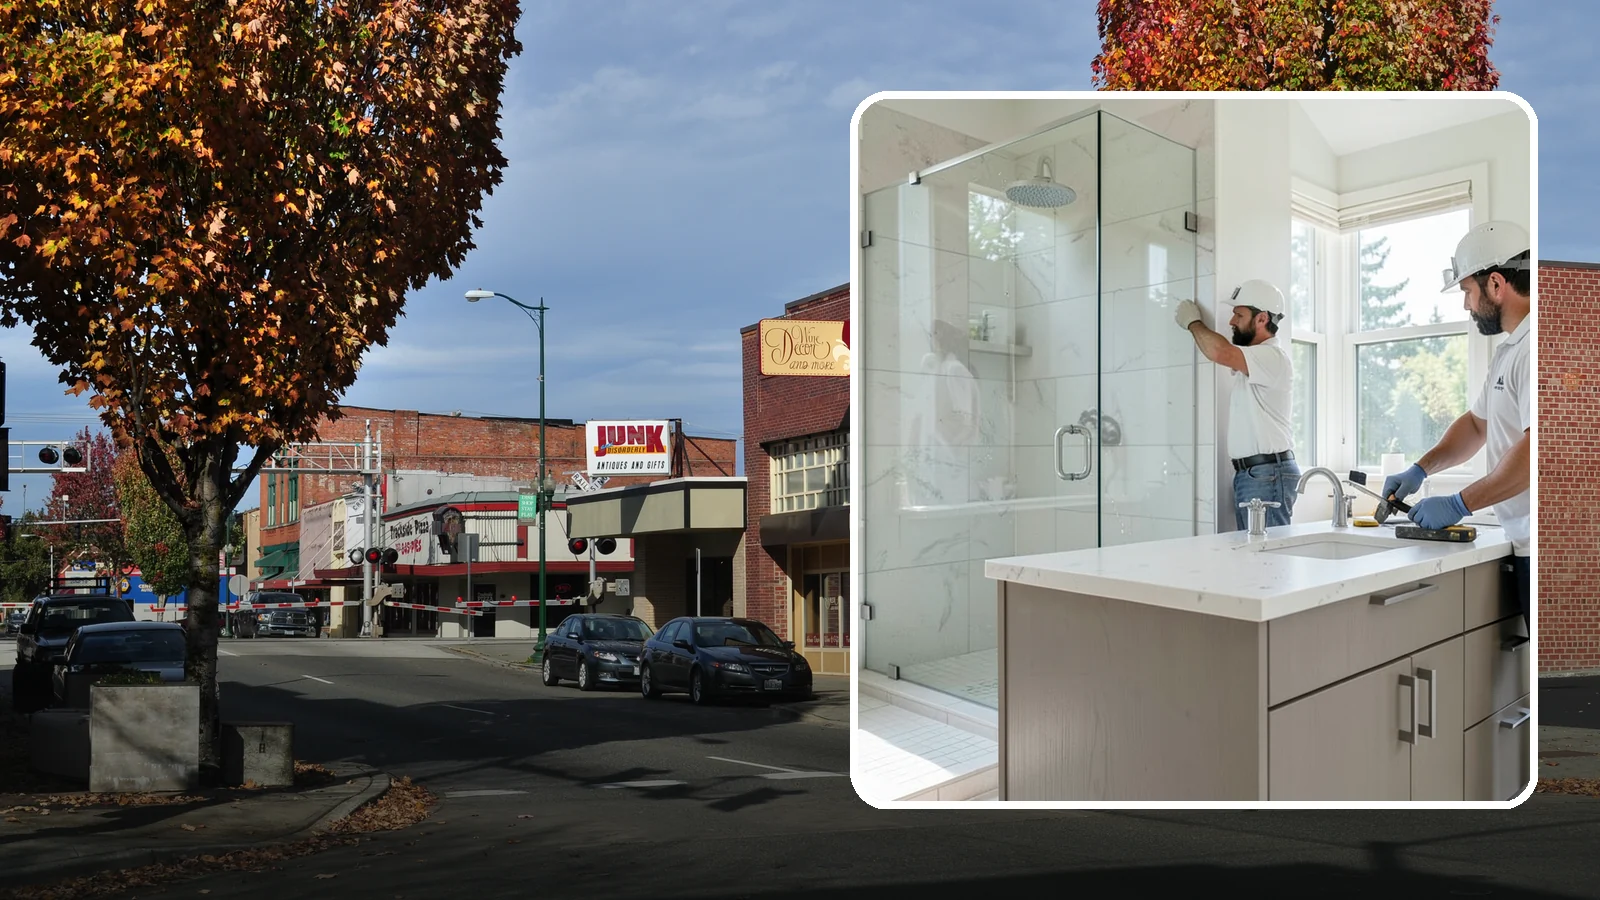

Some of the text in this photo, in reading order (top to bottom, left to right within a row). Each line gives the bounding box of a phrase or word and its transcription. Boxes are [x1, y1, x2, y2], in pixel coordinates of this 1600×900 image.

[595, 425, 665, 457] JUNK
[607, 446, 646, 454] DISORDERLY
[596, 460, 665, 470] ANTIQUES AND GIFTS
[414, 519, 429, 535] Pizza
